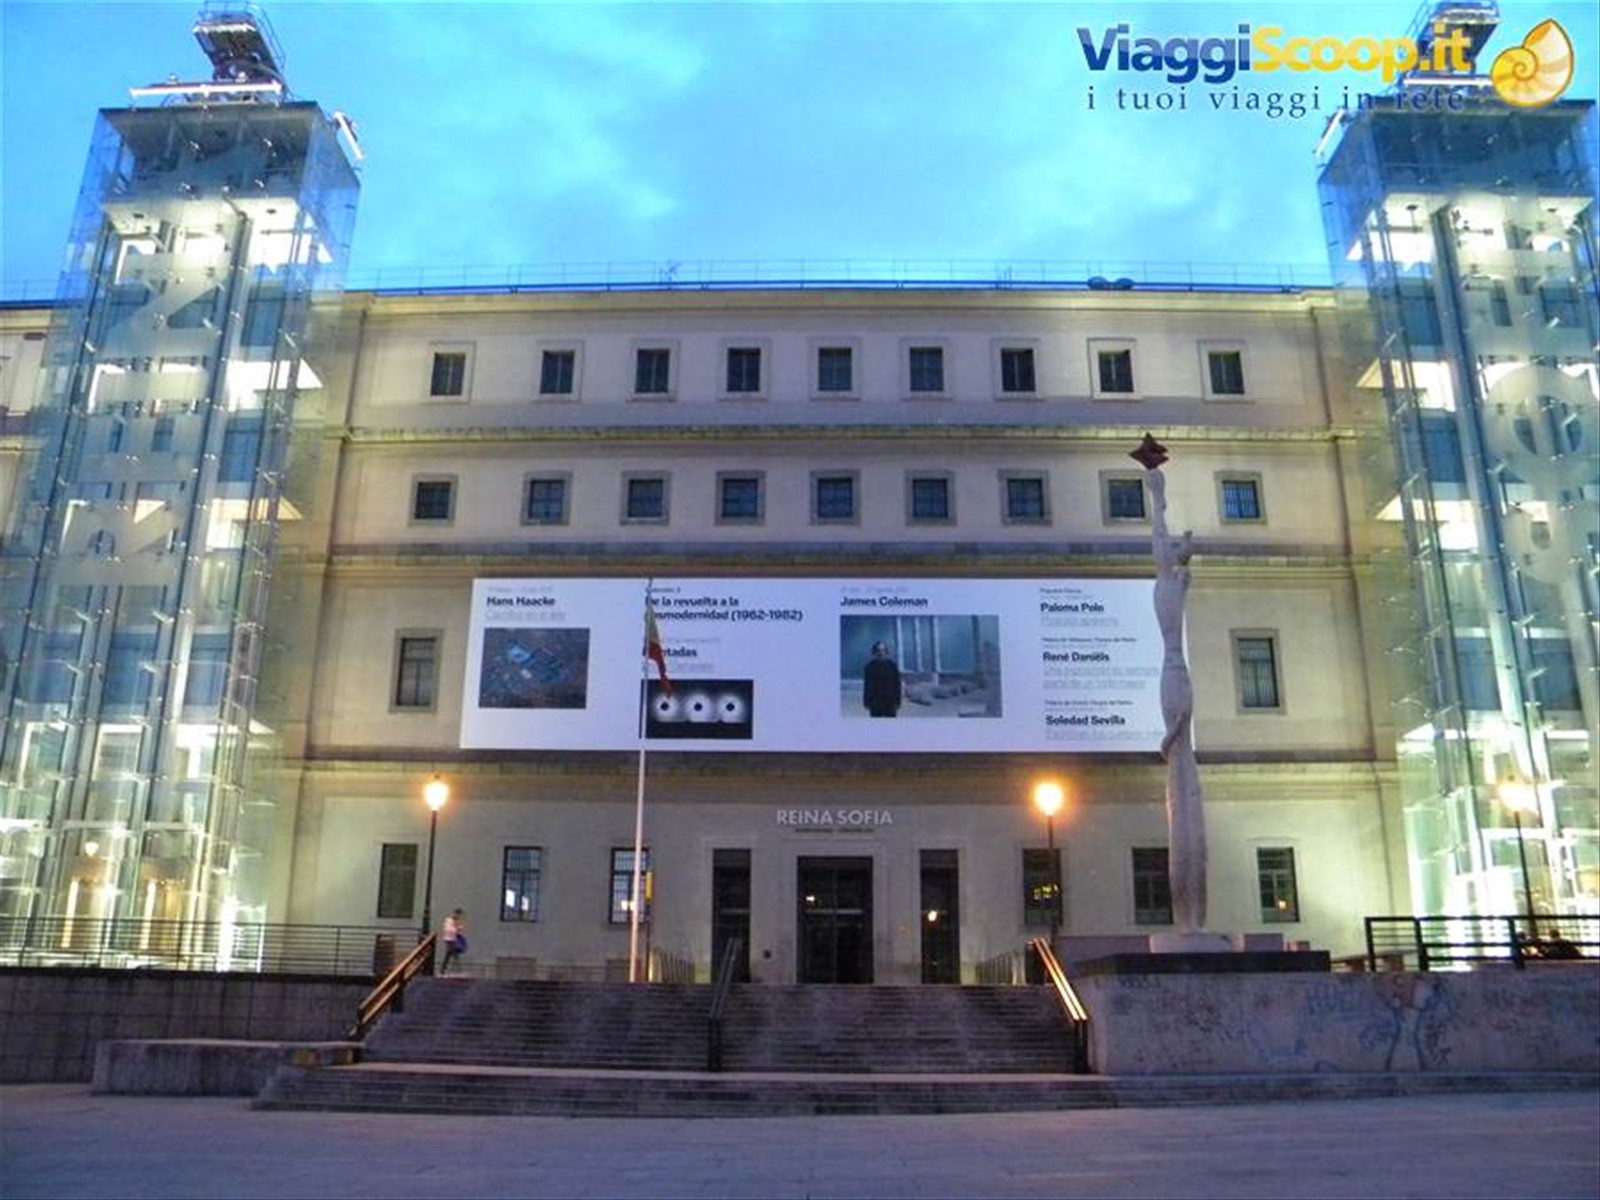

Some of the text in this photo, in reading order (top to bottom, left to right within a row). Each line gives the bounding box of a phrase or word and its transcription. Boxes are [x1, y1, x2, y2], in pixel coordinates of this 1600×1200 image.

[486, 596, 556, 607] Hans Haacke
[662, 597, 671, 606] la
[674, 597, 718, 606] revuelta
[729, 597, 739, 606] la
[841, 596, 928, 607] James Coleman
[1040, 602, 1104, 612] Paloma Polo
[731, 609, 803, 621] (1962-1982)
[1043, 651, 1070, 661] René
[1045, 714, 1125, 725] Soledad Sevilla
[776, 809, 894, 825] REINA SOFIA
